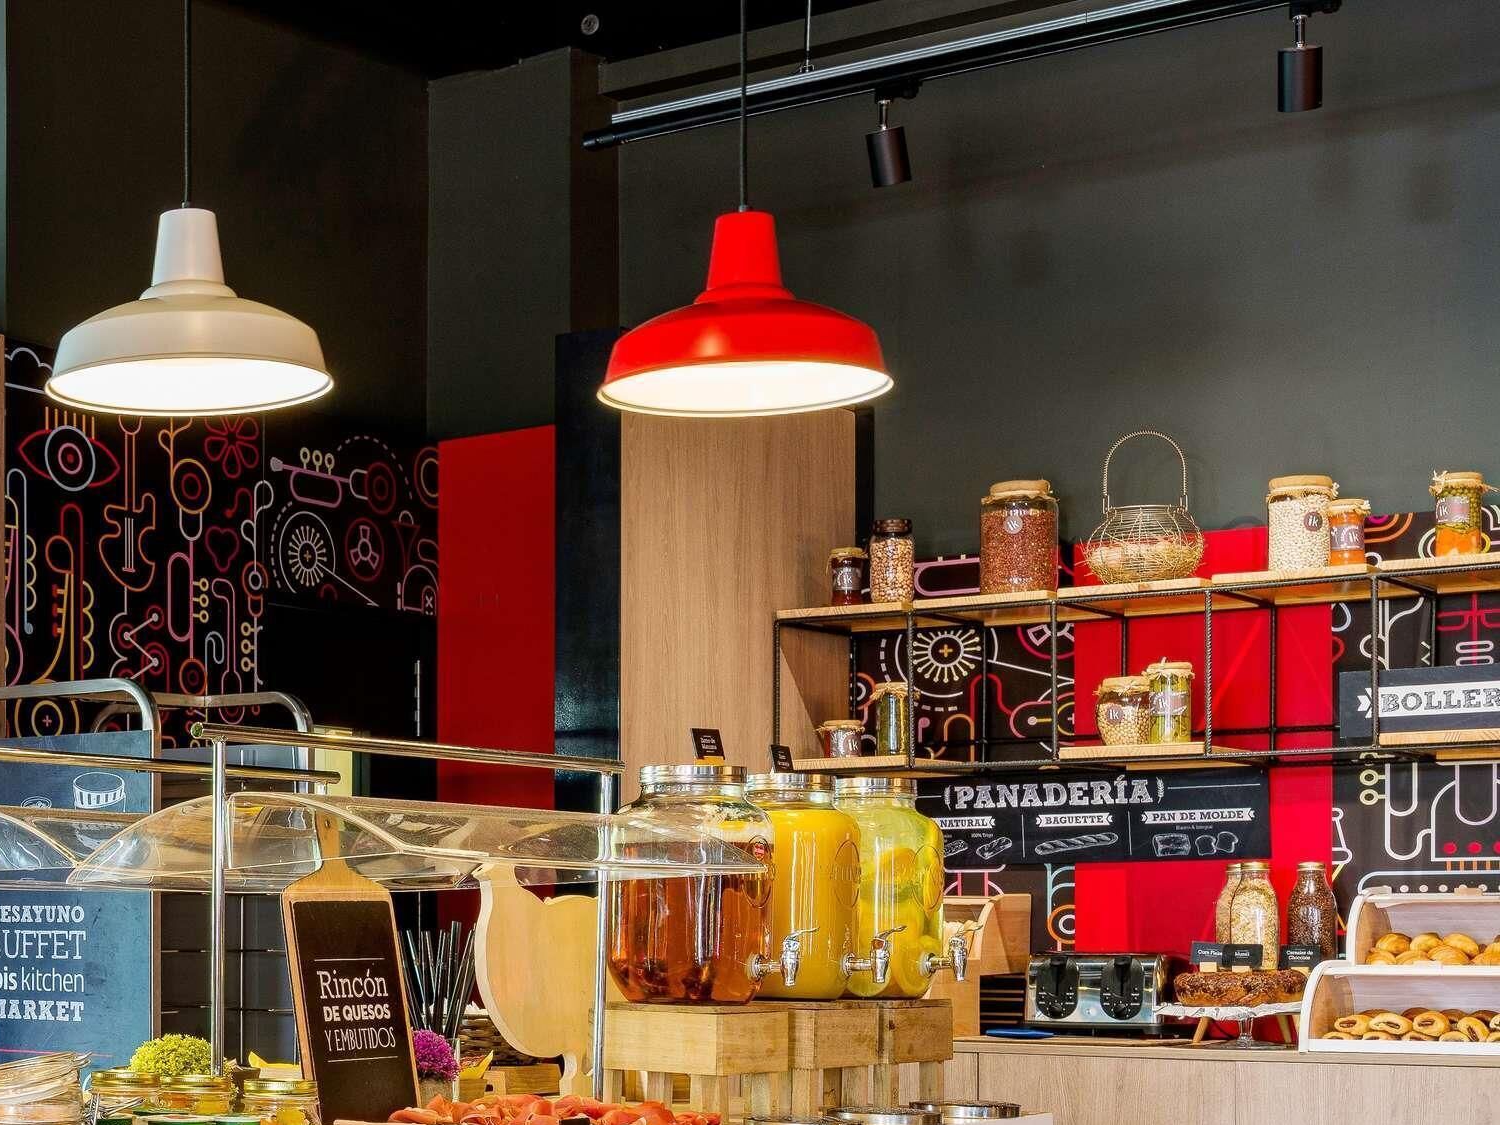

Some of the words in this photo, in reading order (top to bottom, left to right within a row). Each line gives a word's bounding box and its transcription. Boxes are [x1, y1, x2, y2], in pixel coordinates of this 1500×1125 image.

[954, 775, 1154, 809] PANADERÍA
[940, 818, 988, 828] NATURAL
[1045, 814, 1104, 825] BAGUETTE
[1152, 813, 1175, 821] PAN
[1180, 812, 1196, 820] DE
[1200, 810, 1244, 820] MOLDE
[21, 966, 85, 992] kitchen
[316, 968, 389, 999] Rincón
[323, 1005, 341, 1021] DE
[342, 1003, 391, 1021] QUESOS
[324, 1029, 332, 1051] Y
[334, 1026, 396, 1051] EMBUTIDOS
